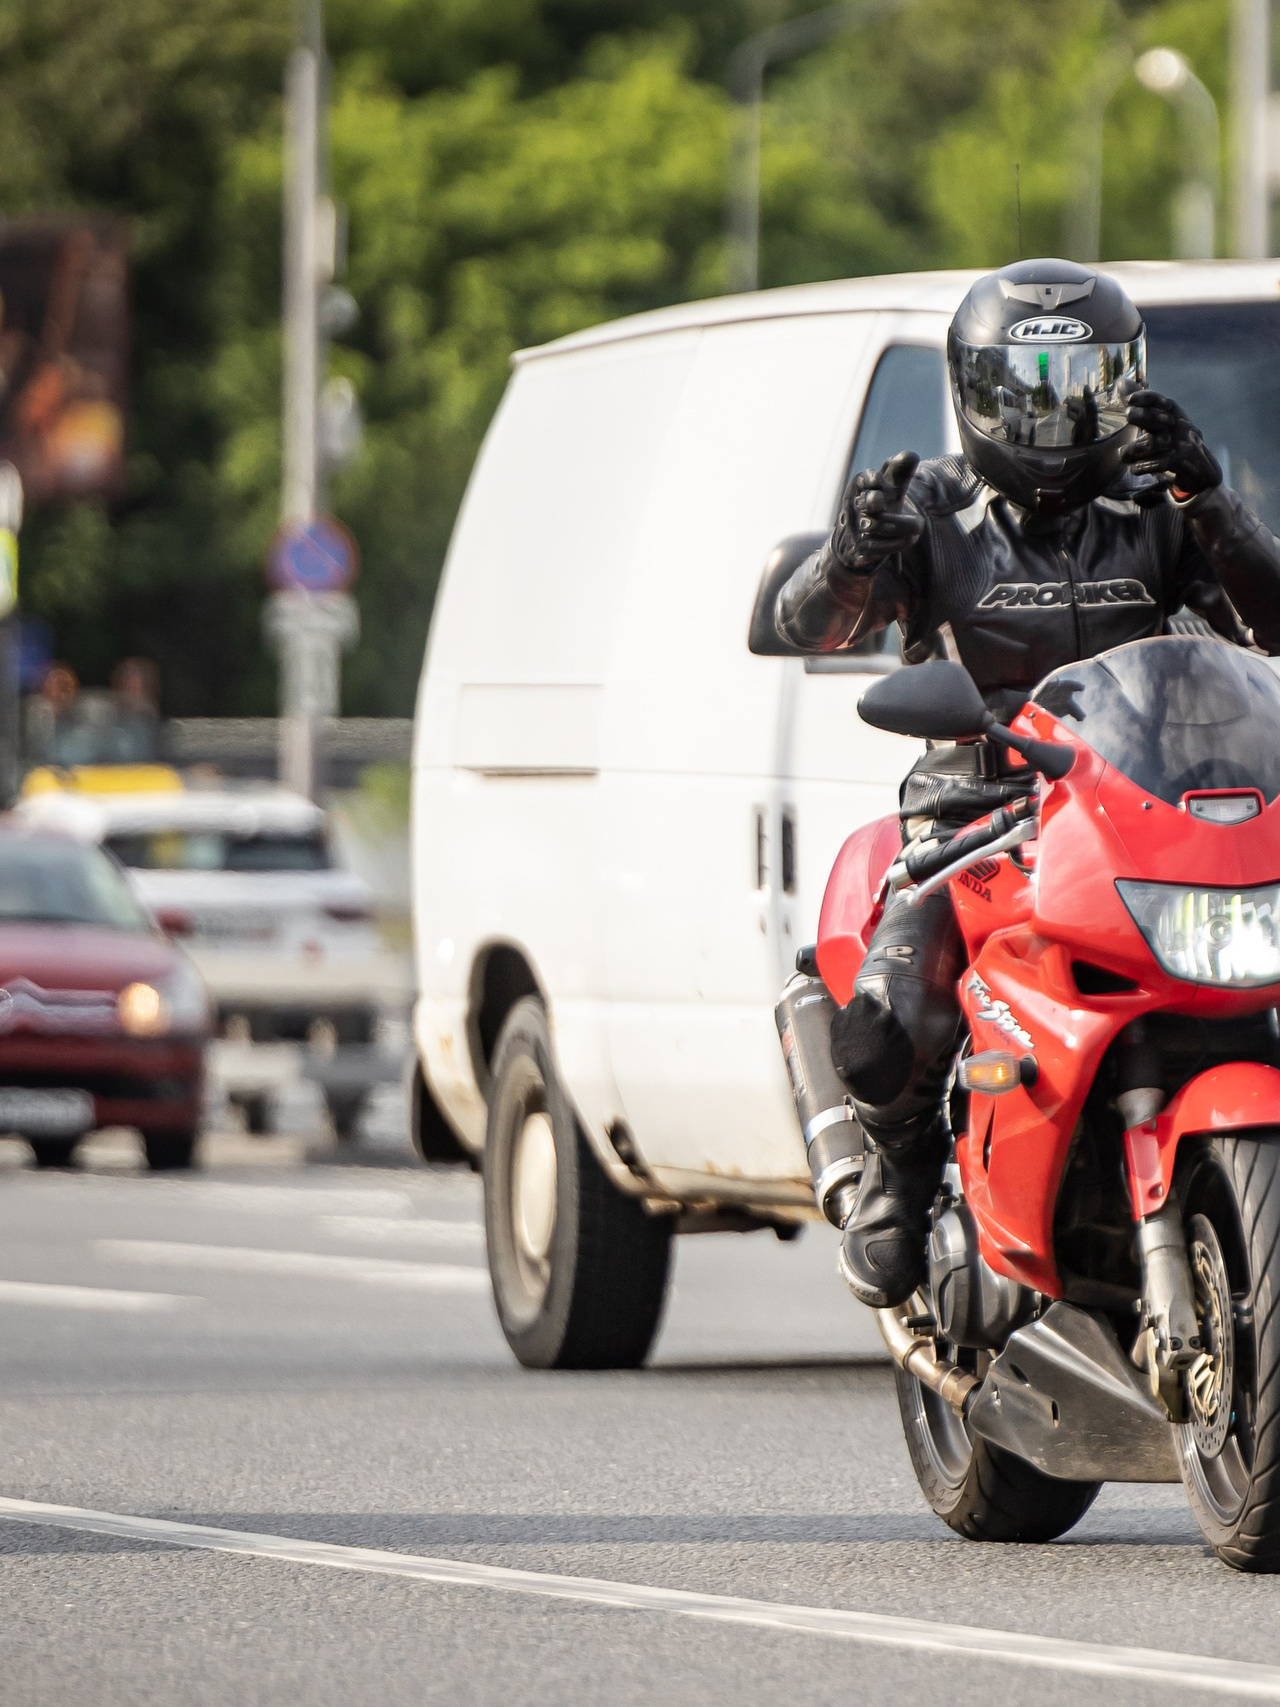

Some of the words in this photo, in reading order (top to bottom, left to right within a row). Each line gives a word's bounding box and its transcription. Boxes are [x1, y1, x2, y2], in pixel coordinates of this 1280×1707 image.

[1021, 322, 1080, 336] HJC
[977, 578, 1157, 609] PROBIKER
[956, 871, 992, 903] NDA
